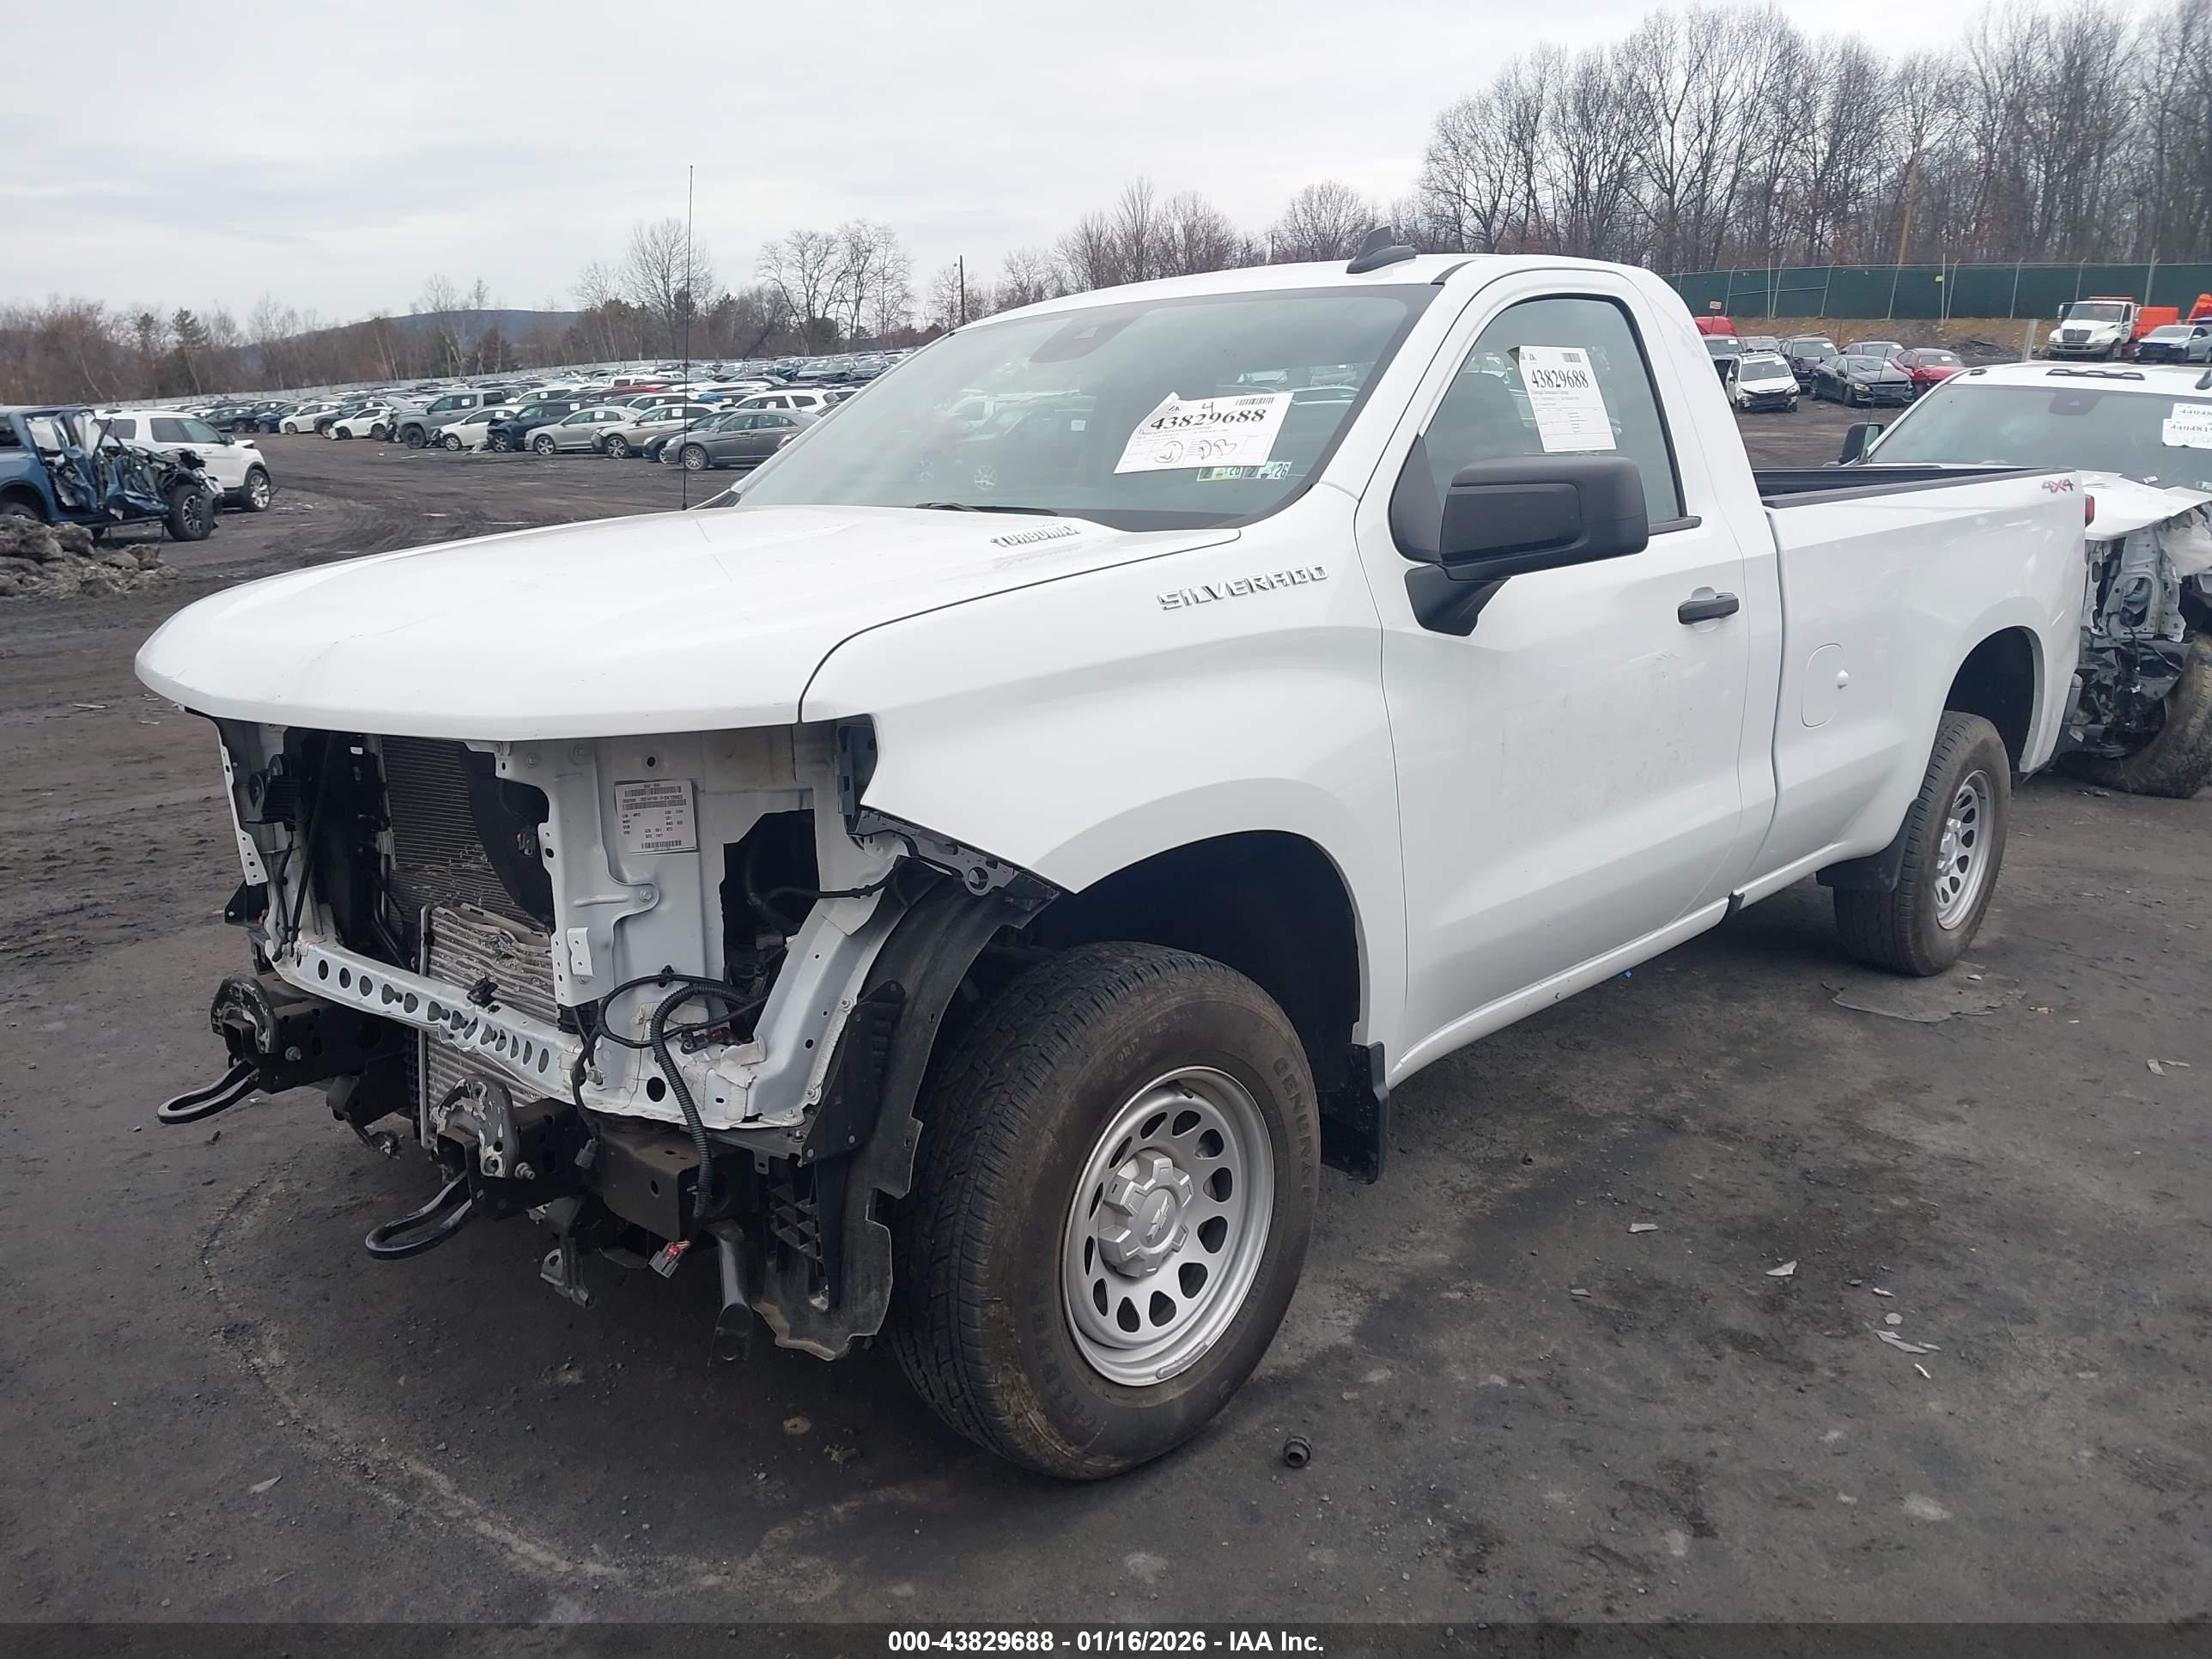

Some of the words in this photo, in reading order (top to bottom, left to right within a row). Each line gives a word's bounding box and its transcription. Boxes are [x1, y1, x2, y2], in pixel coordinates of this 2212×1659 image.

[1531, 368, 1589, 389] 43829688
[1150, 408, 1267, 430] 43829688
[1274, 463, 1290, 478] 26
[990, 525, 1081, 547] TURBOMAX
[1157, 564, 1329, 611] SILVERADO
